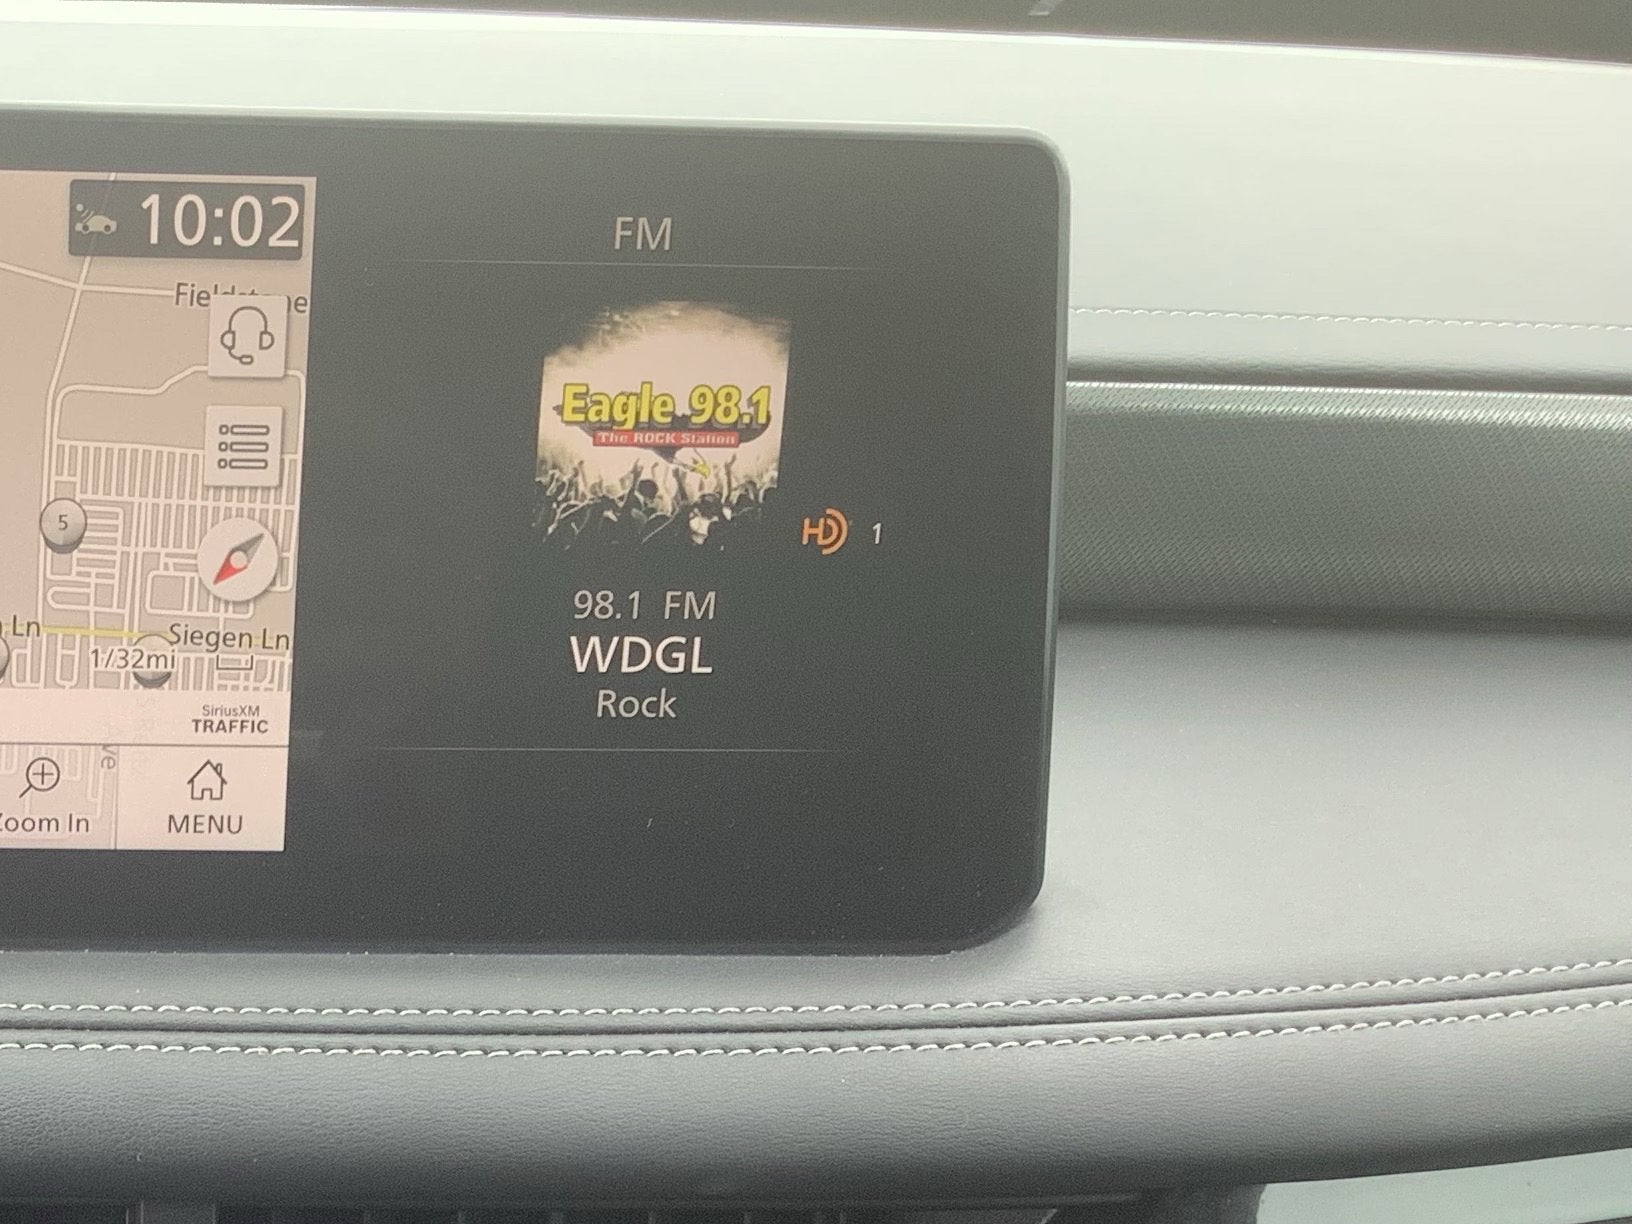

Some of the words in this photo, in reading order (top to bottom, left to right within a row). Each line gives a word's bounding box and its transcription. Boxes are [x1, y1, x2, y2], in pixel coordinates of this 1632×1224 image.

[140, 193, 300, 248] 10:02
[613, 216, 673, 251] FM
[561, 381, 675, 430] Eagle
[689, 384, 771, 425] 98.1
[597, 431, 628, 444] The
[633, 432, 676, 444] ROCK
[680, 432, 736, 445] Station
[58, 514, 68, 531] 5
[872, 523, 882, 545] 1
[572, 590, 641, 620] 98.1
[664, 590, 718, 620] FM
[12, 615, 41, 638] Ln
[170, 623, 253, 653] Siegen
[262, 628, 290, 651] Ln
[90, 647, 176, 670] 1/32mi
[569, 635, 714, 674] WDGL
[202, 704, 261, 717] SiriusXM
[596, 687, 678, 719] Rock
[192, 719, 269, 734] TRAFFIC
[68, 813, 91, 833] In
[167, 814, 244, 835] MENU
